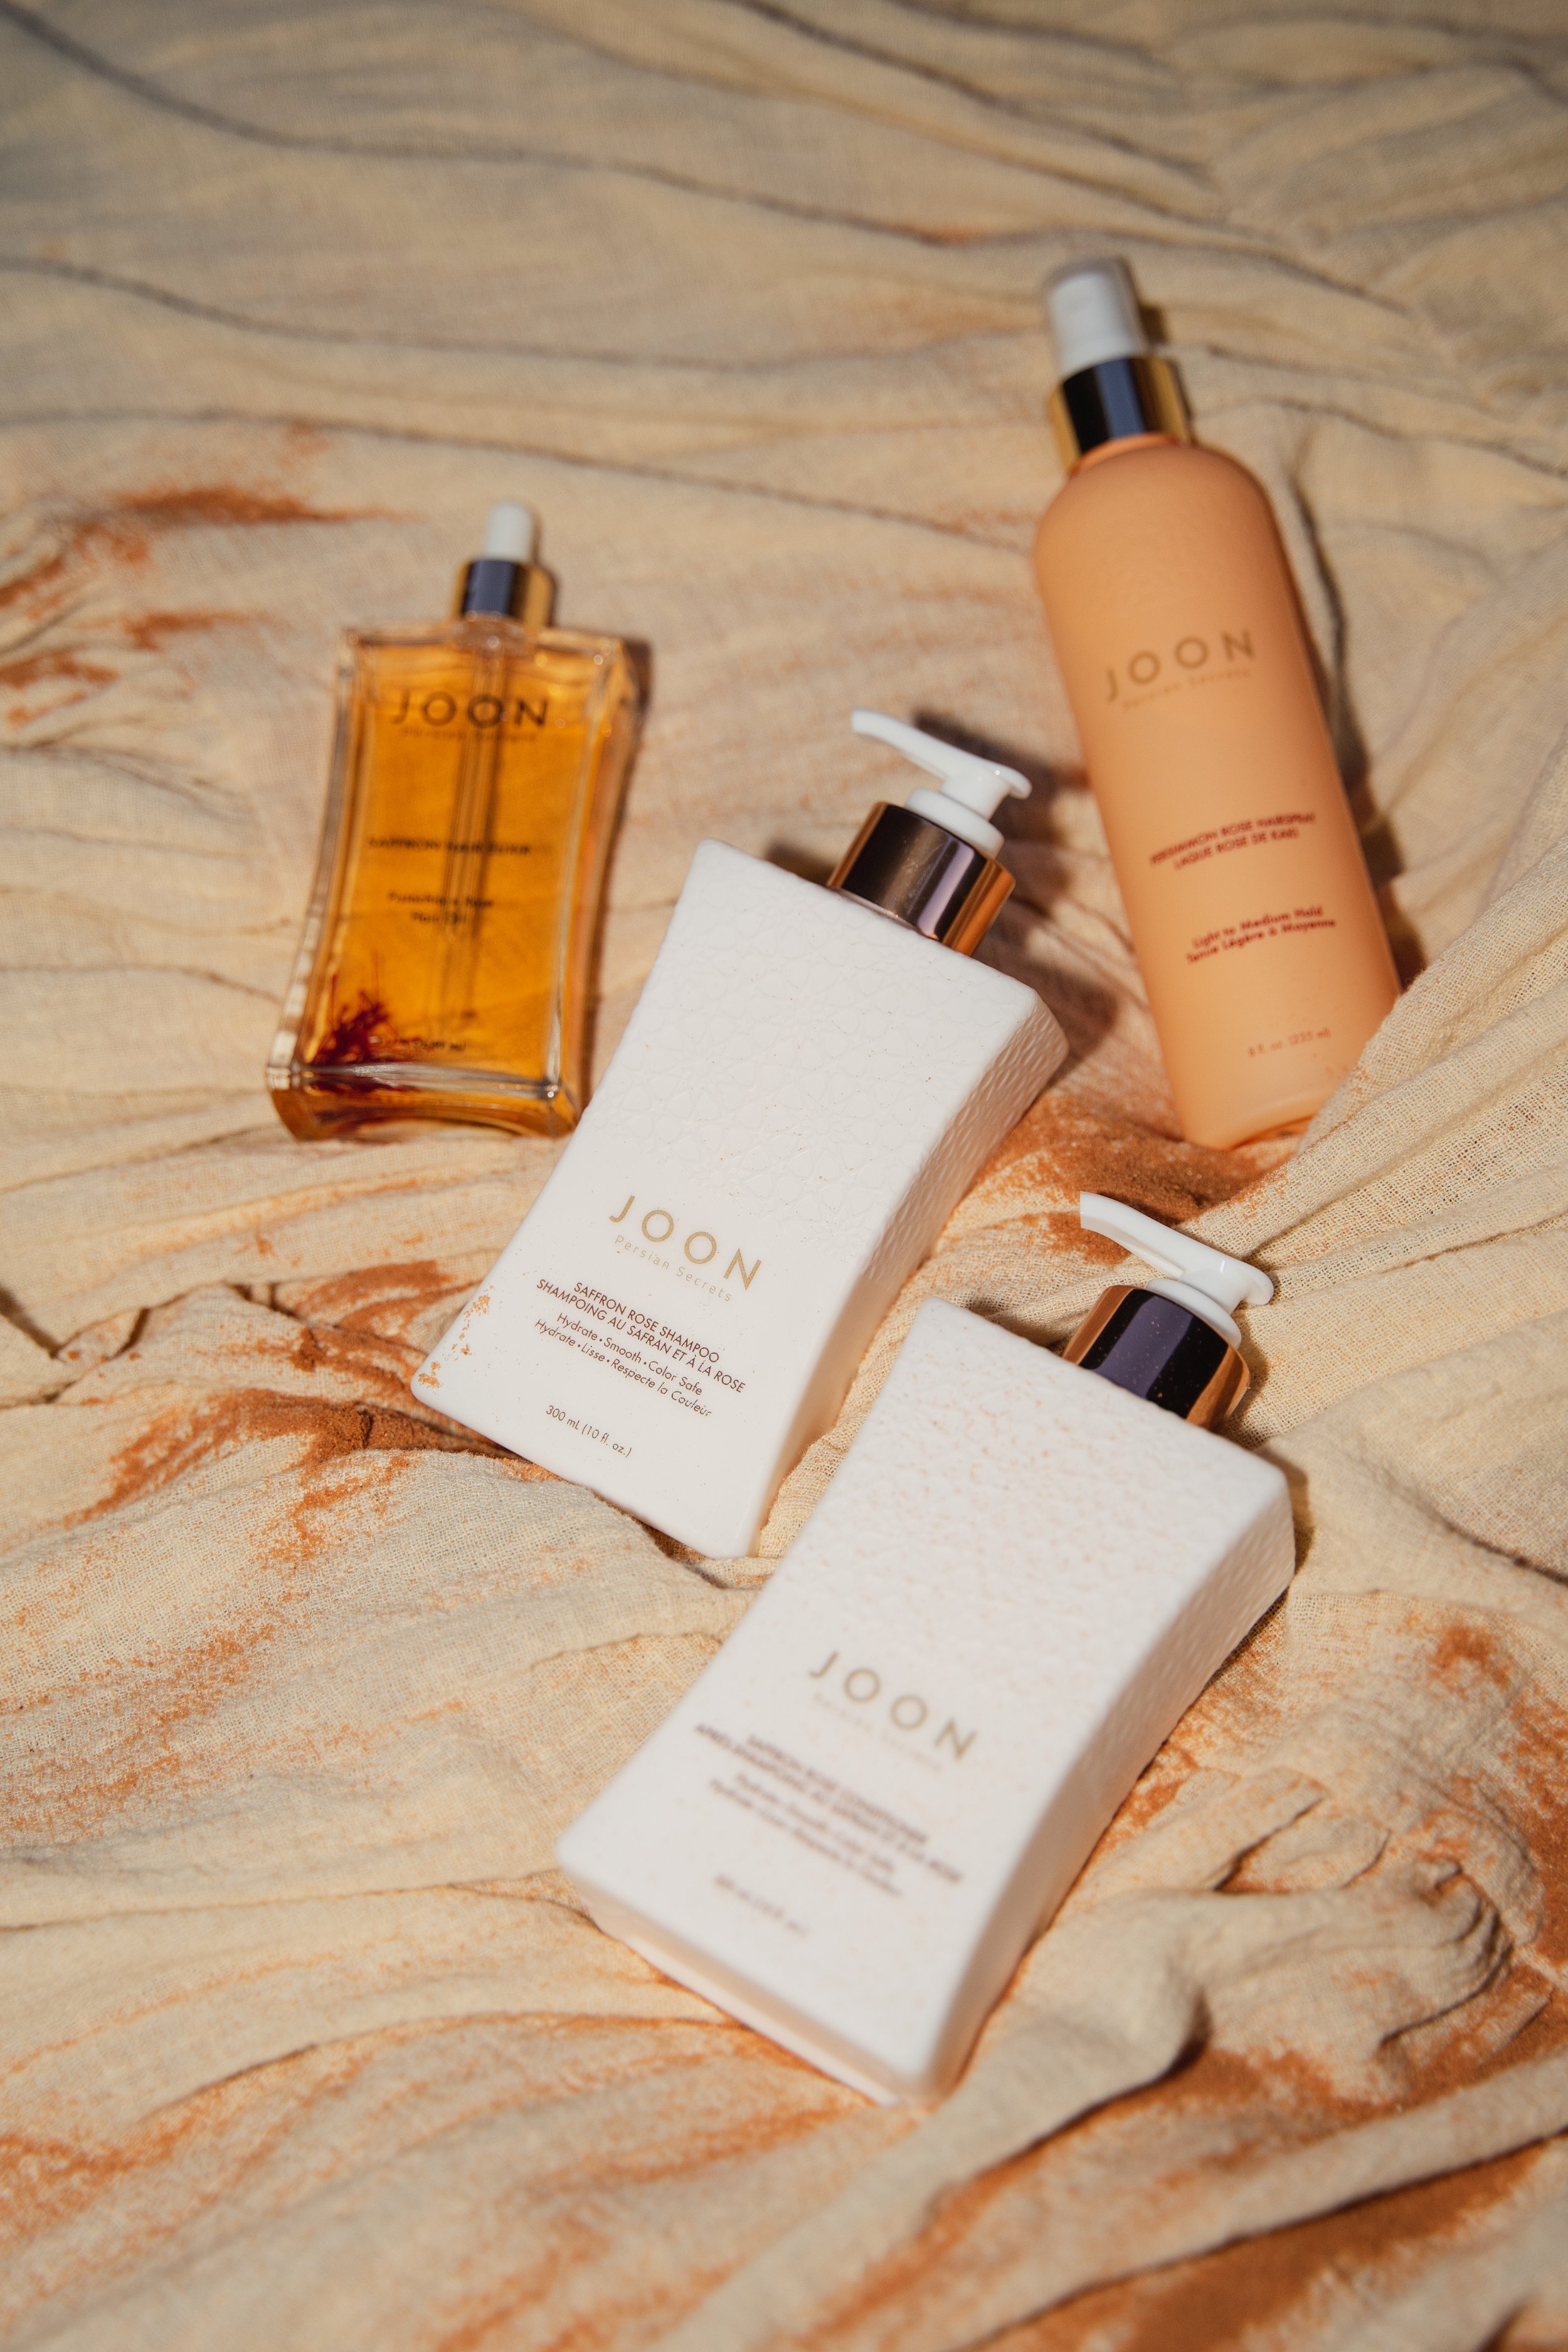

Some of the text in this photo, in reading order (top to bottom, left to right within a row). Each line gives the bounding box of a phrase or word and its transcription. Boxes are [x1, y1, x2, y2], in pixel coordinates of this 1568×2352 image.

[1106, 629, 1254, 703] JOON
[392, 691, 548, 728] JOON
[1215, 837, 1248, 854] ROSE
[1251, 832, 1268, 845] DE
[1221, 818, 1253, 837] ROSE
[1192, 905, 1323, 949] Light to Medium Hold
[609, 1195, 761, 1291] JOON
[615, 1235, 732, 1301] Persian Secrets
[537, 1279, 746, 1392] SHAMPOING AU SAFRAN ET À LA ROSE
[557, 1313, 702, 1396] Hydrate Smooth Color Safe
[574, 1282, 719, 1362] SAFFRON ROSE SHAMPOO
[534, 1319, 711, 1416] Hydrate Lisse Respecte la Couleur
[546, 1405, 632, 1458] 300 mL (10 fl. oz.)
[808, 1651, 978, 1762] JOON
